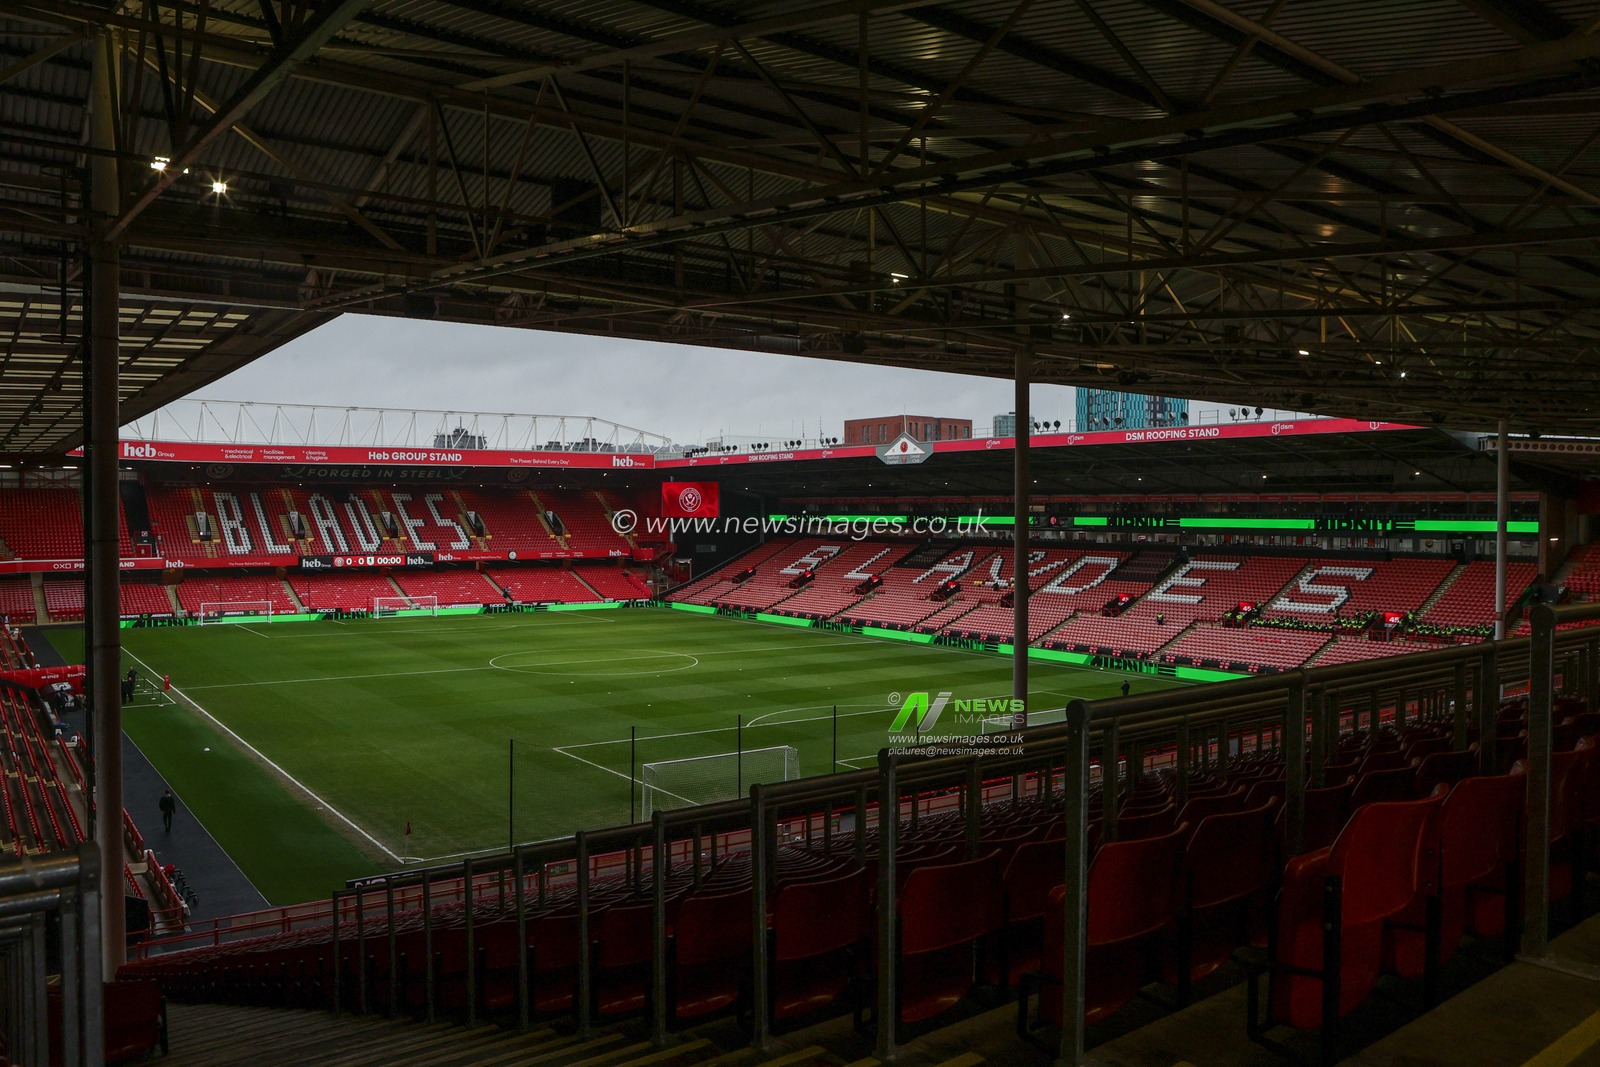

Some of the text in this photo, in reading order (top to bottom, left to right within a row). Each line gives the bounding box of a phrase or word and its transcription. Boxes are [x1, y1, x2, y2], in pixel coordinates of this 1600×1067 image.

[1125, 428, 1220, 441] DSM ROOFING STAND
[123, 442, 157, 458] heb
[368, 451, 463, 462] Heb GROUP STAND
[612, 456, 634, 467] heb
[306, 468, 443, 479] FORGED IN STEEL
[345, 557, 353, 565] 0
[358, 557, 365, 565] 0
[376, 556, 402, 565] 00:00
[407, 556, 424, 565] heb
[438, 553, 453, 561] heb
[165, 559, 184, 568] heb
[302, 558, 321, 568] heb
